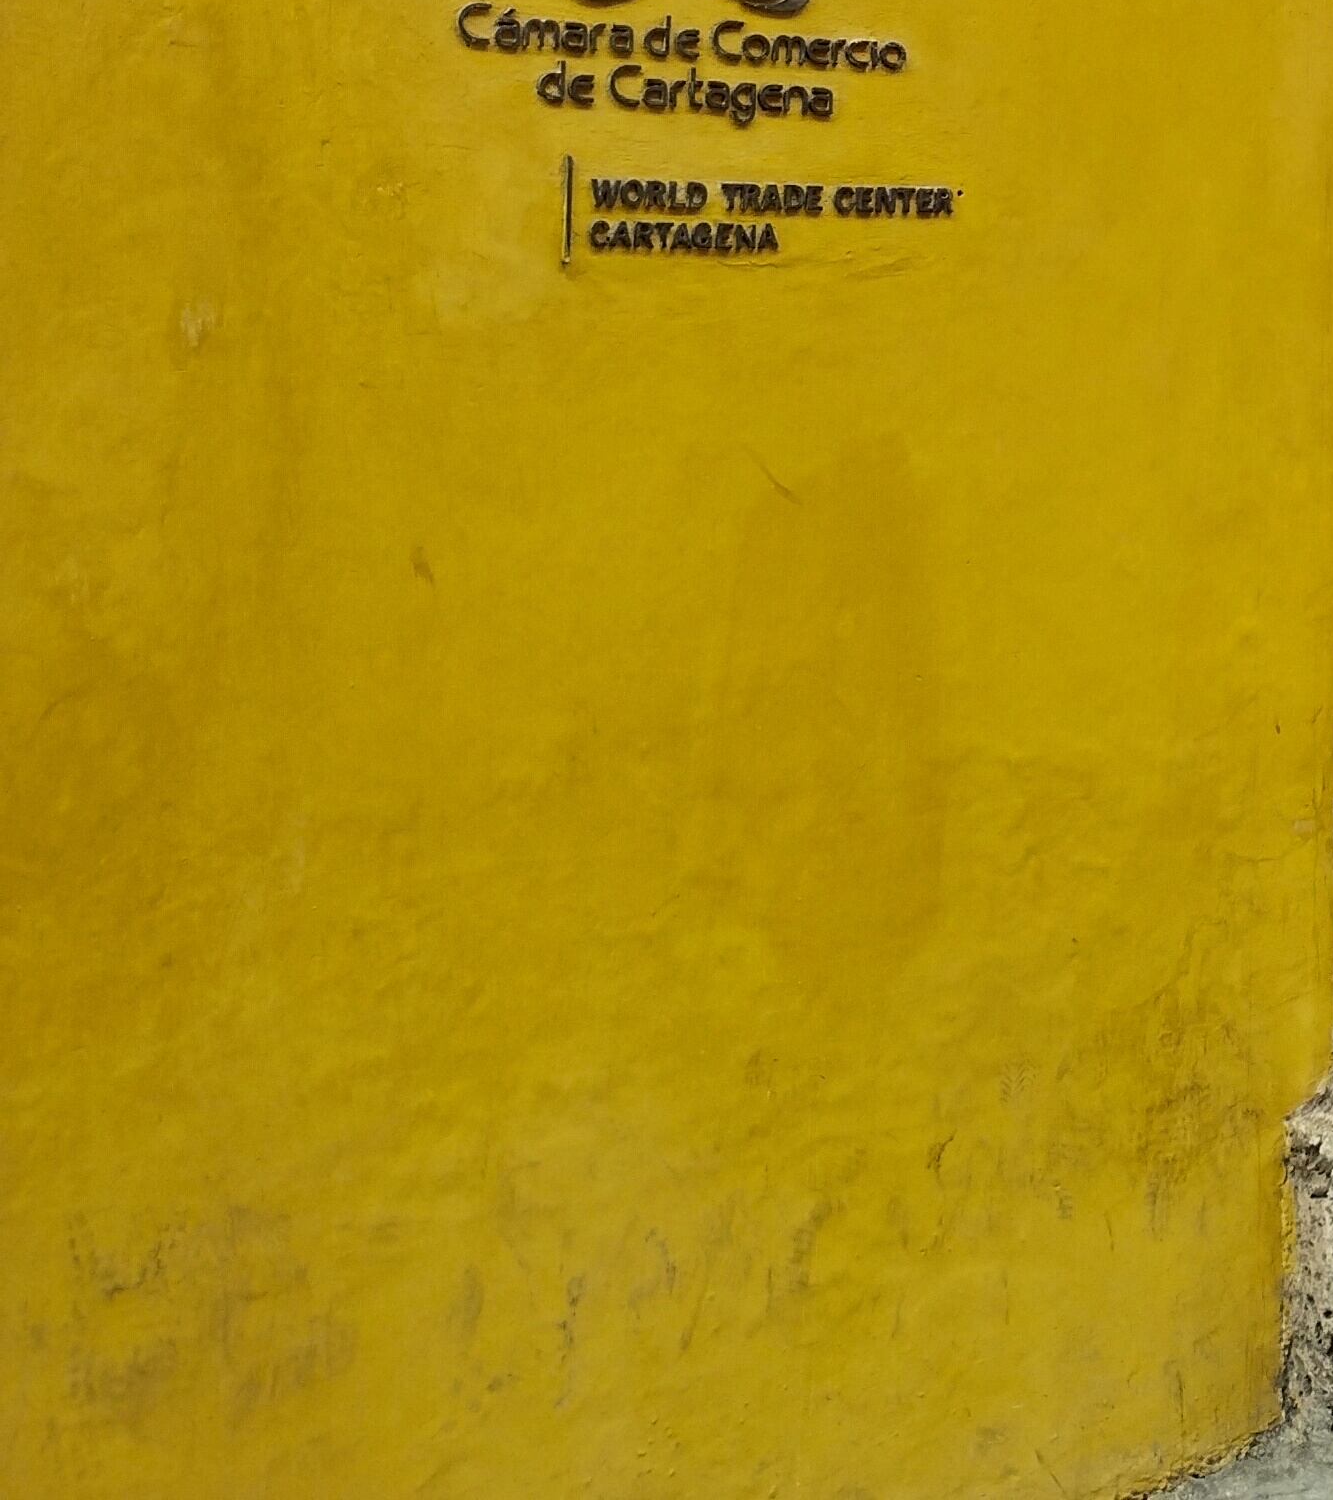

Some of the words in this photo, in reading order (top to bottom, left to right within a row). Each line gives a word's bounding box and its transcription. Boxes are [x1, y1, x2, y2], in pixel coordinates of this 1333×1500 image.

[456, 2, 634, 57] Cámara
[644, 15, 701, 61] de
[712, 20, 909, 71] Comercio
[536, 60, 595, 105] de
[609, 64, 834, 127] Cartagena
[591, 178, 708, 211] WORLD
[721, 182, 824, 214] TRADE
[832, 185, 954, 217] CENTER
[589, 219, 780, 253] CARTAGENA
